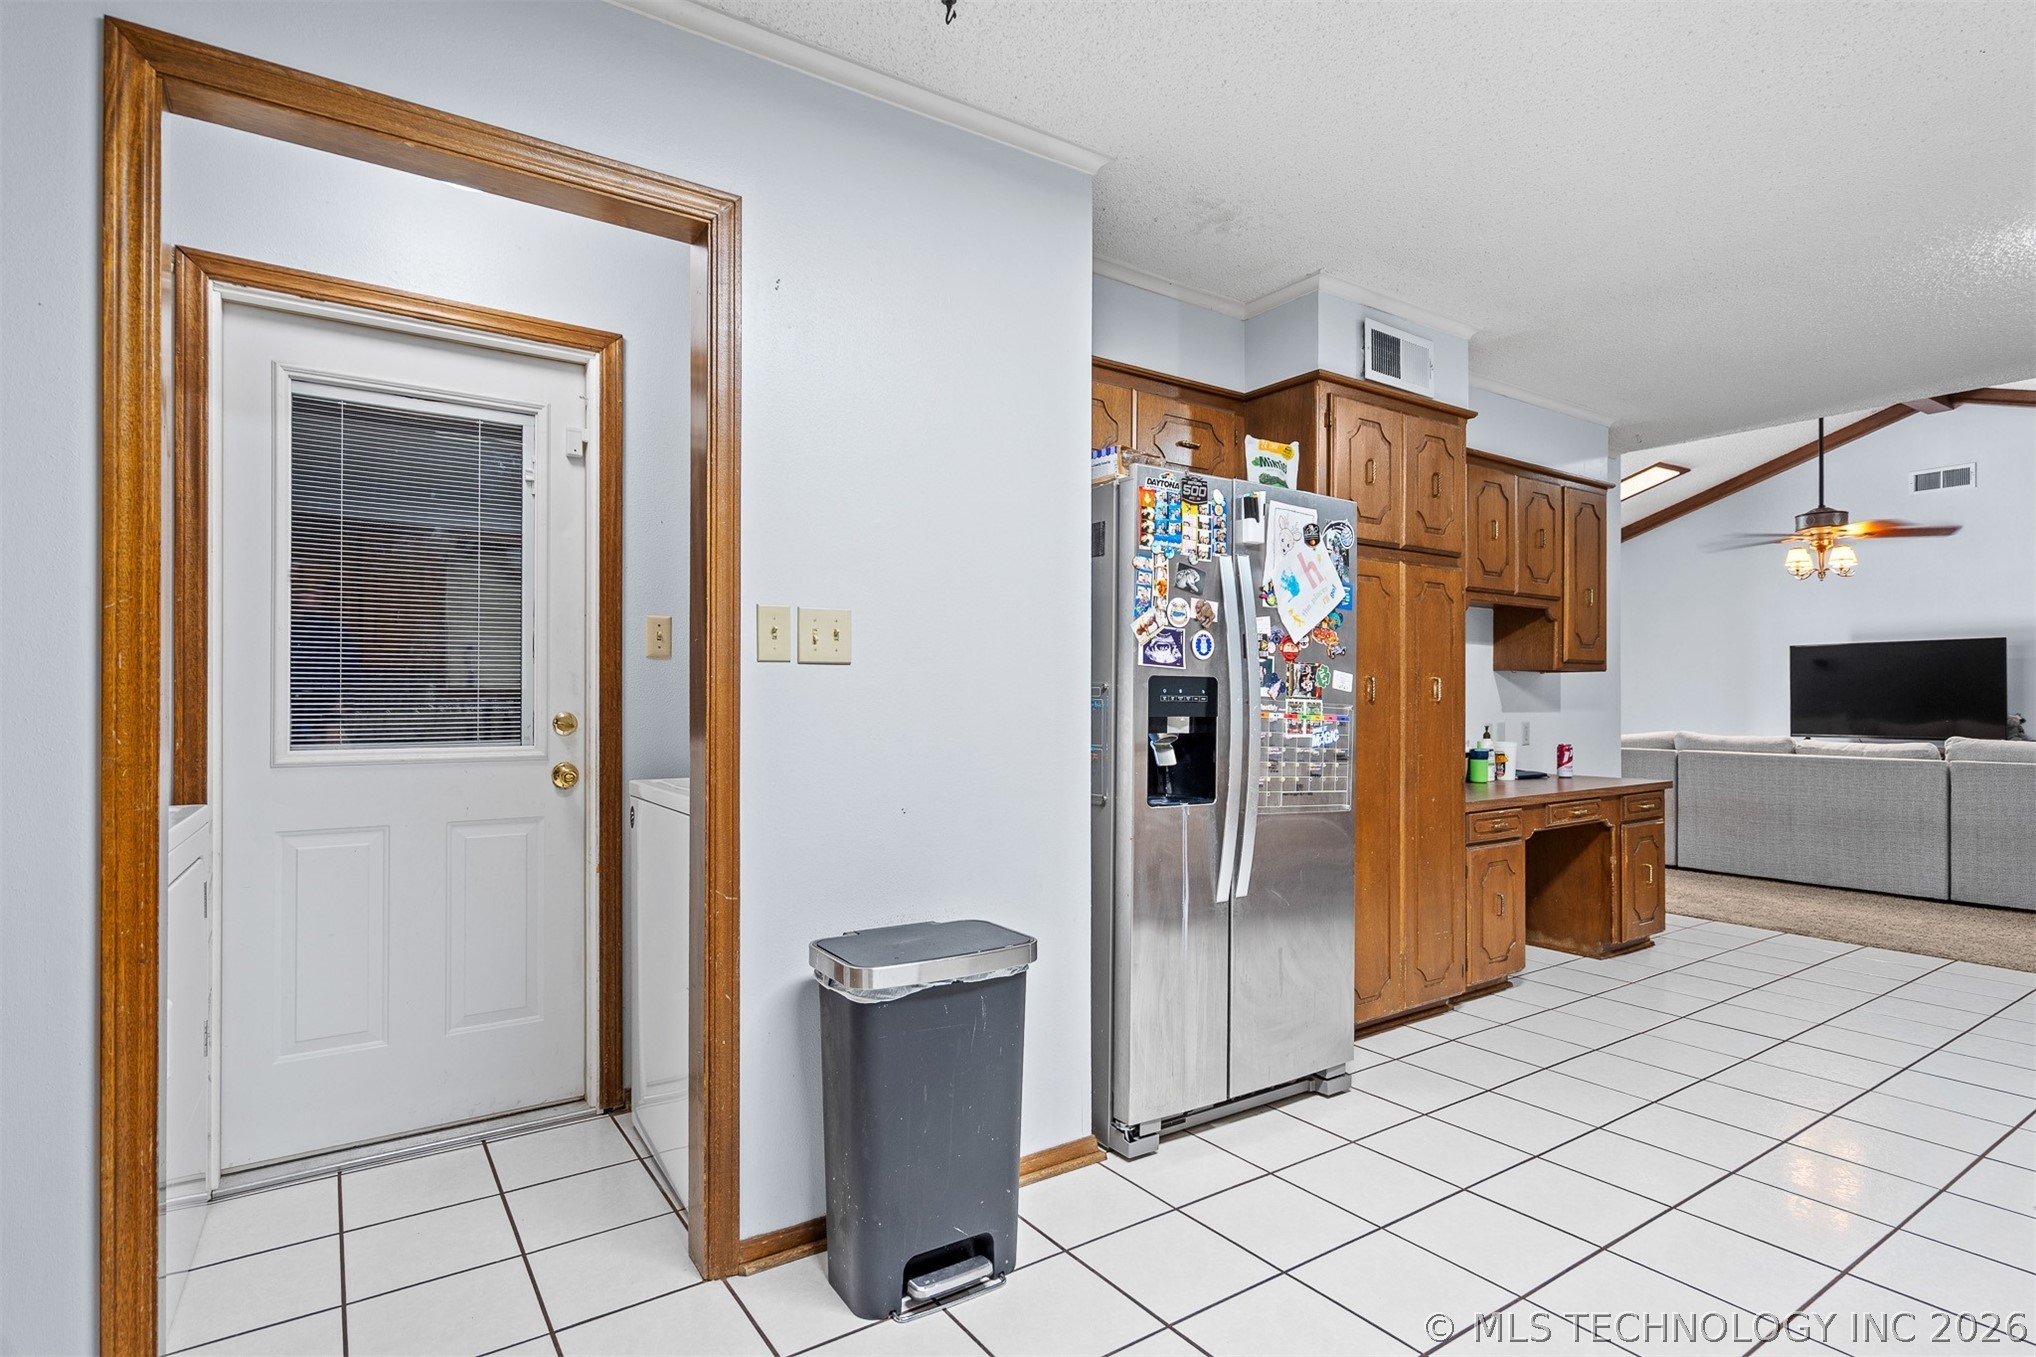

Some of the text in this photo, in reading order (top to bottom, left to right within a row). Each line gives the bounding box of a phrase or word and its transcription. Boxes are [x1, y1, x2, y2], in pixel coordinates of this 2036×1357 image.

[1146, 477, 1180, 490] DAYTONA
[1182, 484, 1207, 498] 500
[1296, 552, 1325, 590] h
